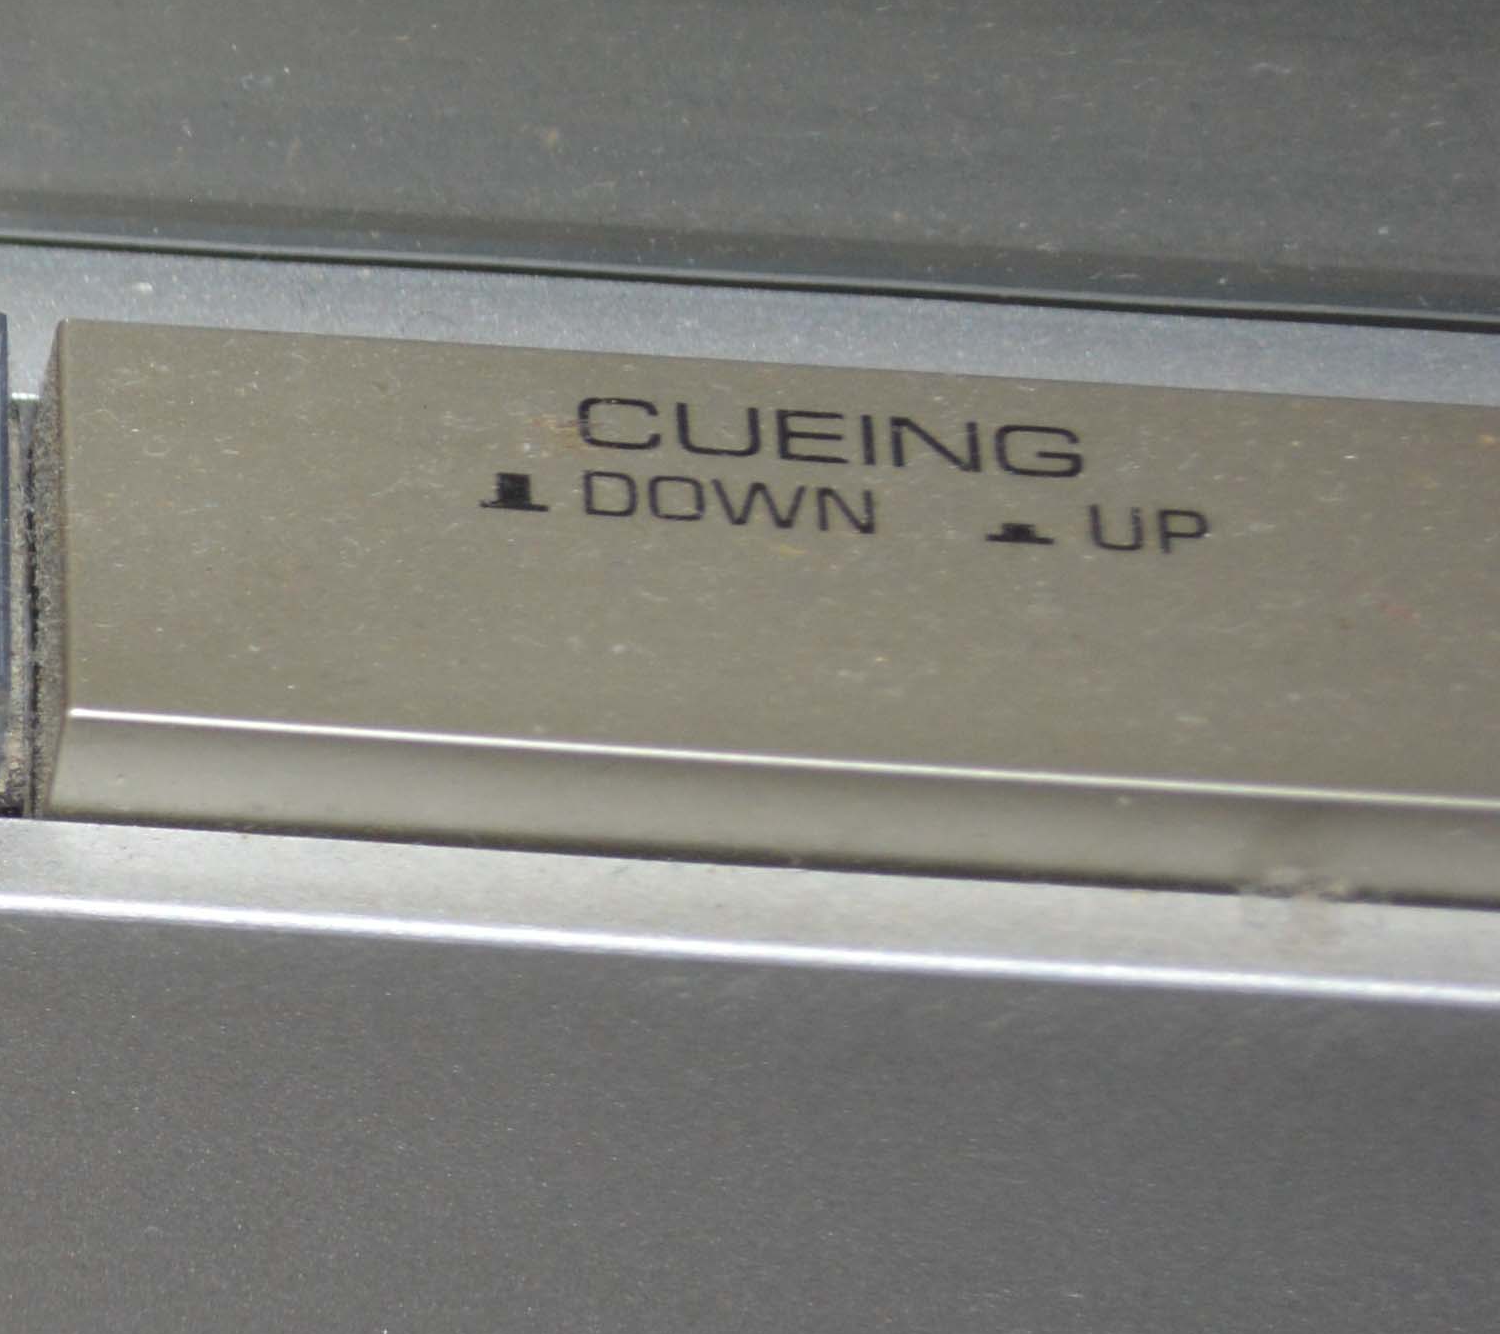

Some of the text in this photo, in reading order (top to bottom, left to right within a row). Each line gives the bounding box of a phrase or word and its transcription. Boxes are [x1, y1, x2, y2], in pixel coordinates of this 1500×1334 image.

[575, 395, 1086, 481] CUEING
[581, 469, 1211, 555] DOWN UP
